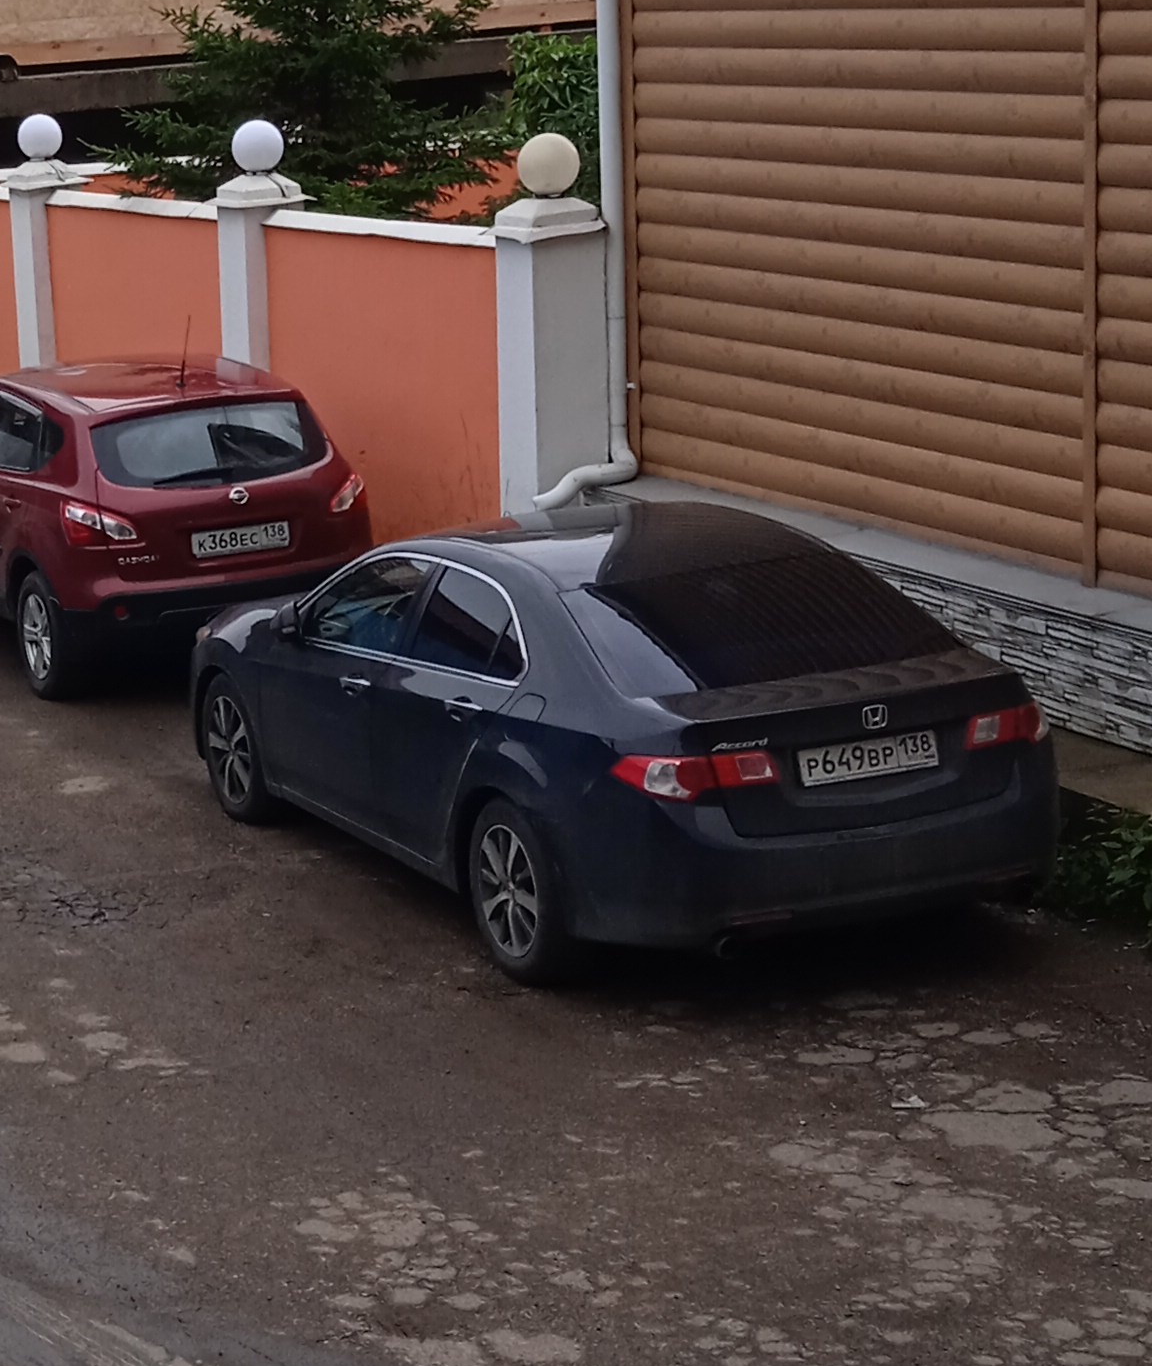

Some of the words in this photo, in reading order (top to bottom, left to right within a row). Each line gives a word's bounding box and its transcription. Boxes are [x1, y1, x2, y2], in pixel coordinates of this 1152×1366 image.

[198, 531, 259, 552] К368ЕС
[262, 523, 285, 539] 138
[711, 737, 769, 752] Accord
[806, 745, 894, 777] Р649ВР
[898, 734, 932, 756] 138
